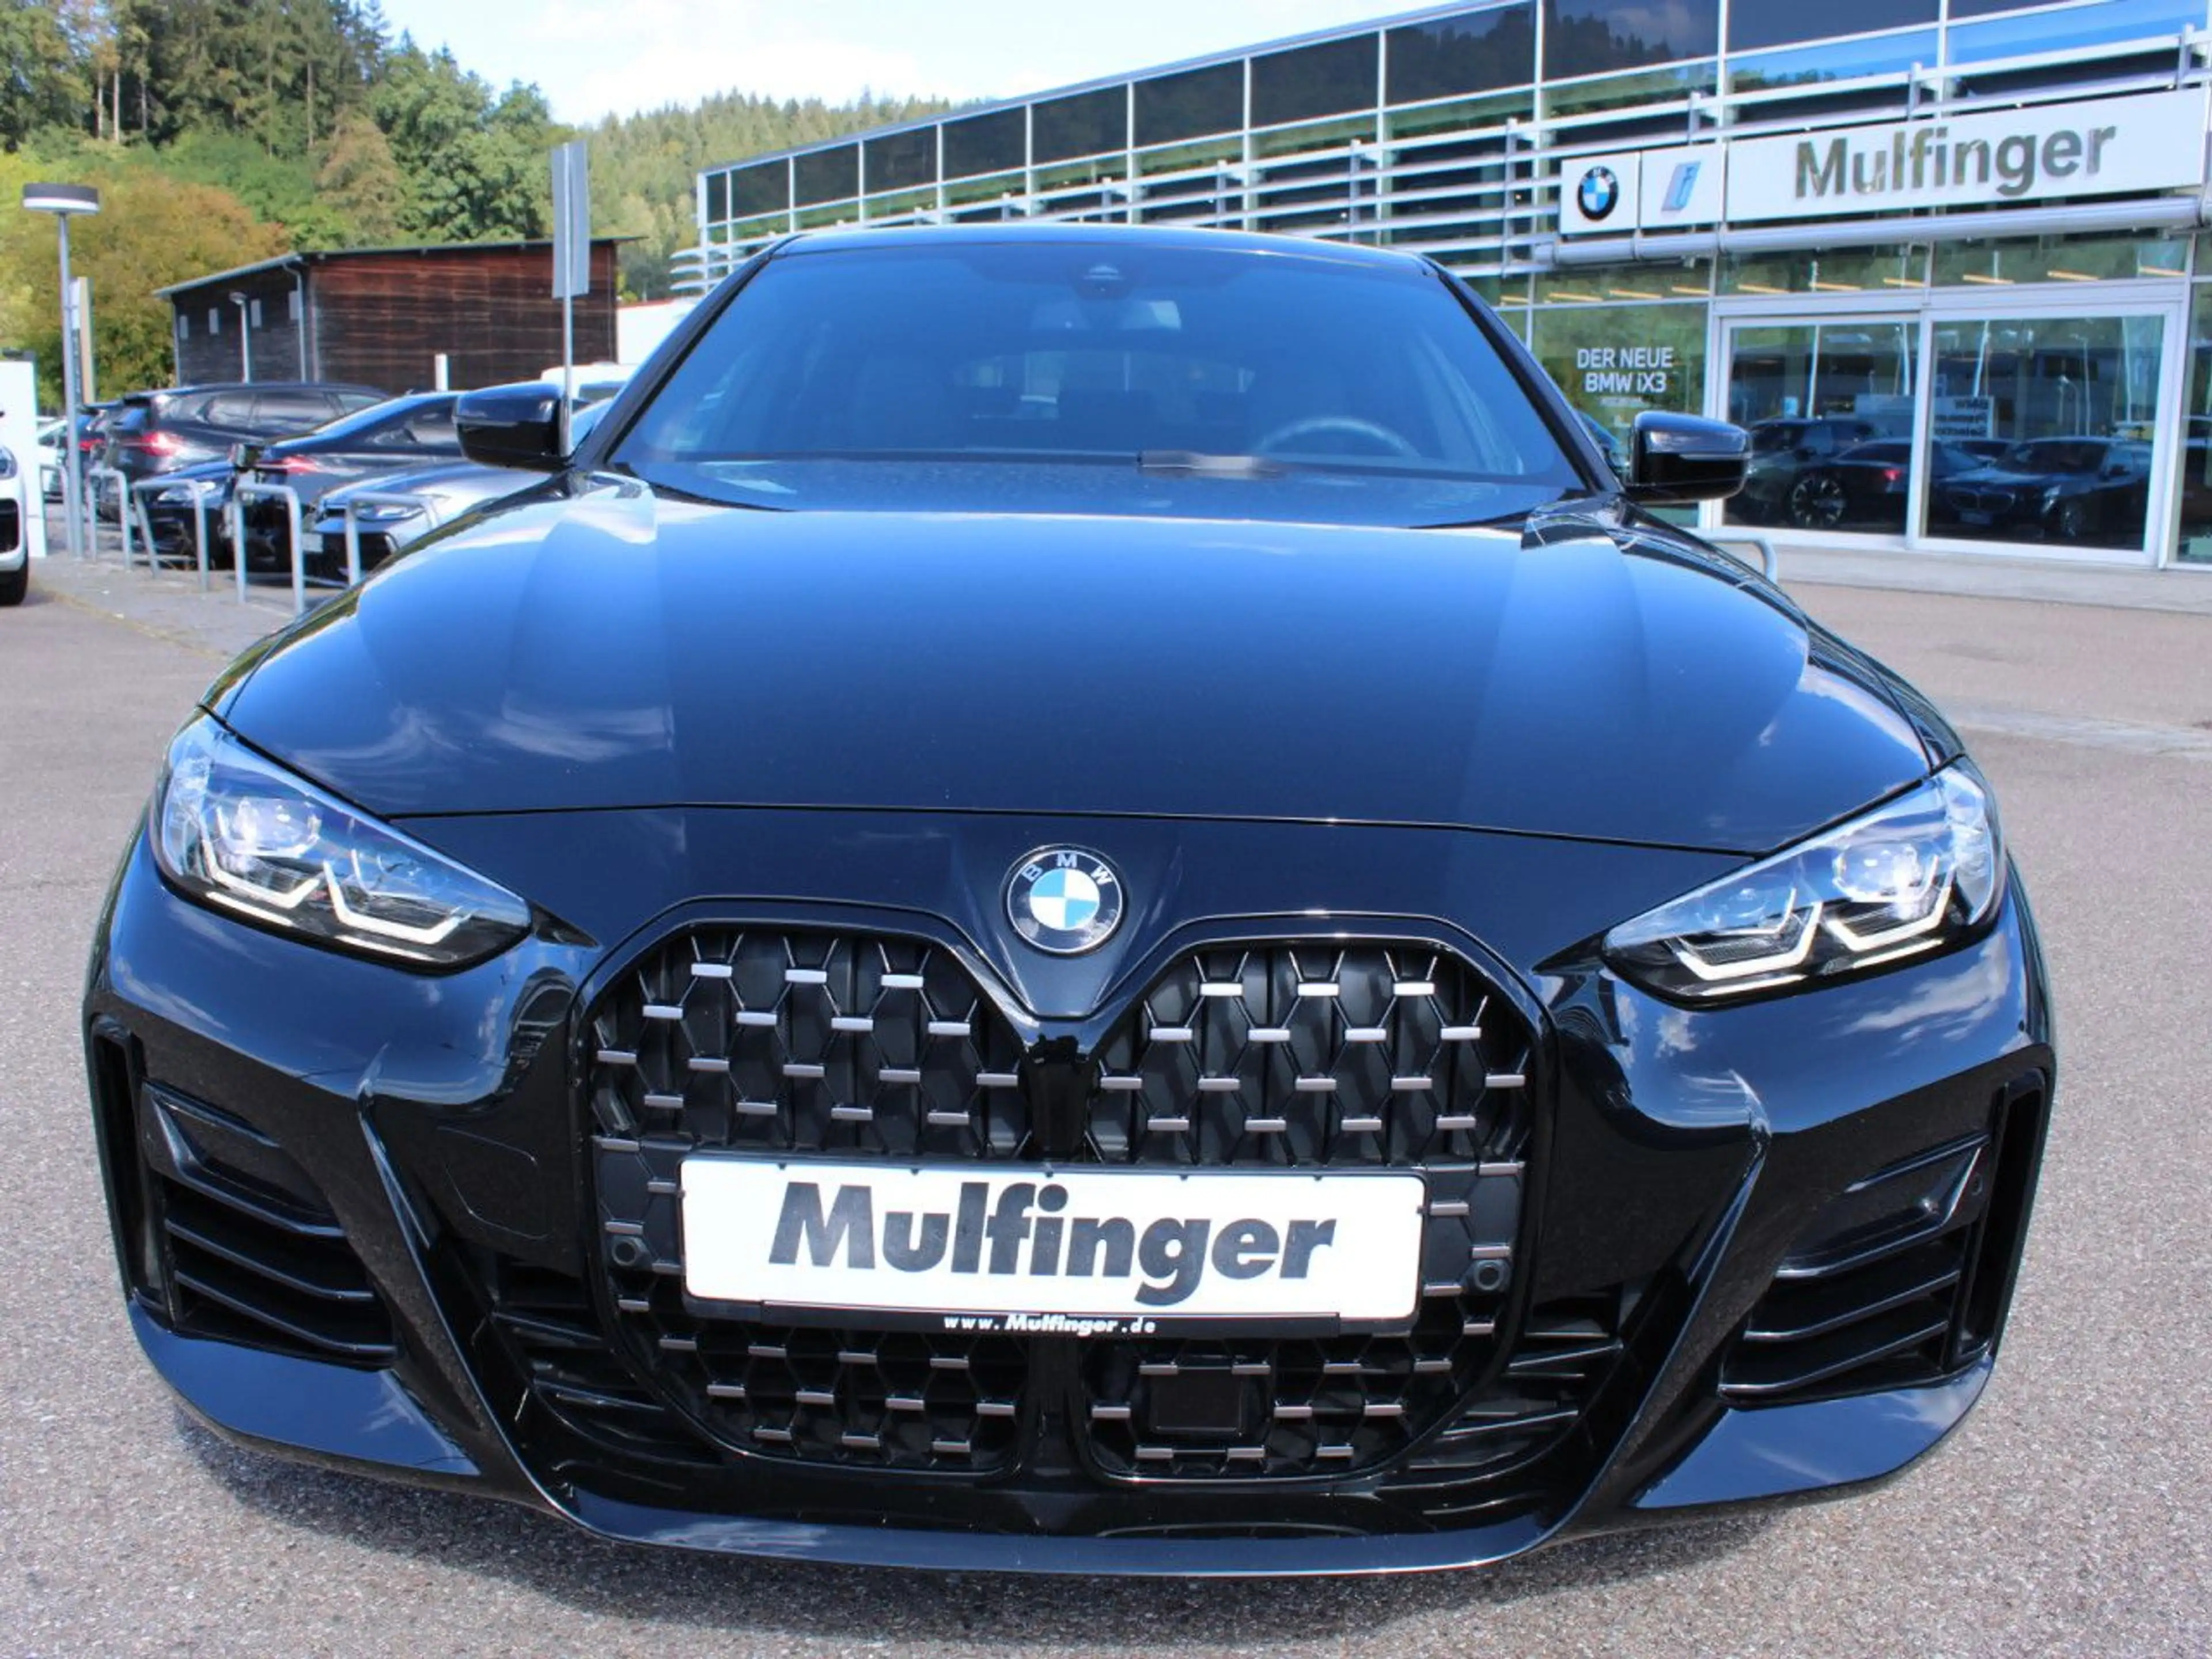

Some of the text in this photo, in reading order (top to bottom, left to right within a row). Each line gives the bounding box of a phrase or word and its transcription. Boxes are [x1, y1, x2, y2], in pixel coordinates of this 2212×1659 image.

[1795, 126, 2116, 198] Mulfinger
[1577, 347, 1674, 369] DER NEUE
[1586, 372, 1633, 393] BMW
[1022, 853, 1112, 885] BMW
[768, 1181, 1336, 1305] Mulfinger
